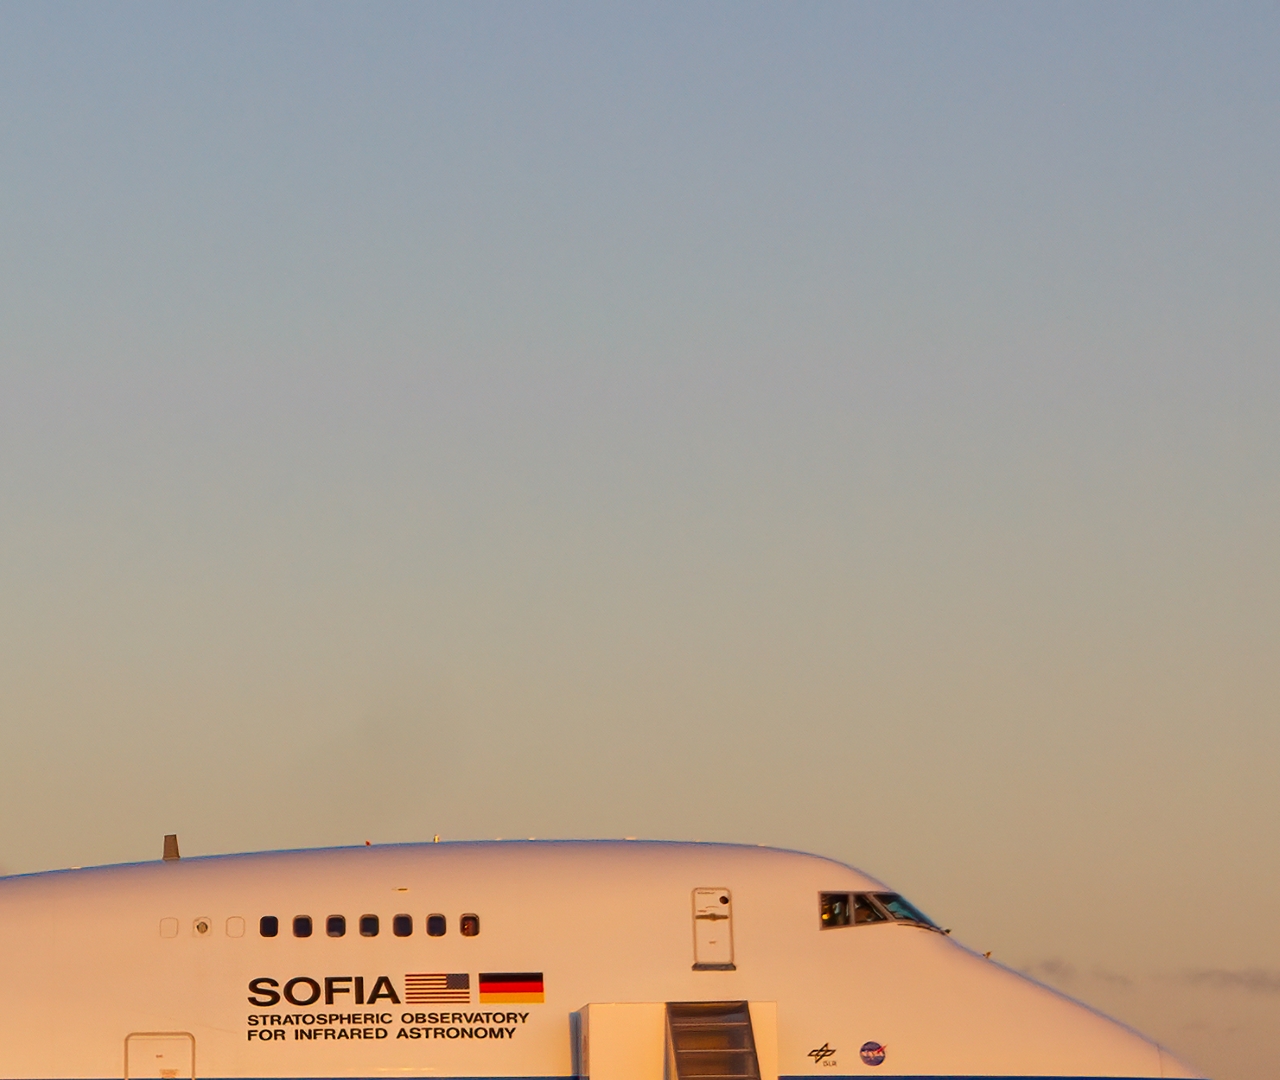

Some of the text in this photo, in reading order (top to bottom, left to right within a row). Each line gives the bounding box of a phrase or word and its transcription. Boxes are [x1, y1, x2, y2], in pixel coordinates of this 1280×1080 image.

[247, 976, 401, 1006] SOFIA
[247, 1012, 529, 1026] STRATOSPHERIC OBSERVATORY
[247, 1027, 517, 1041] FOR INFRARED ASTRONOMY
